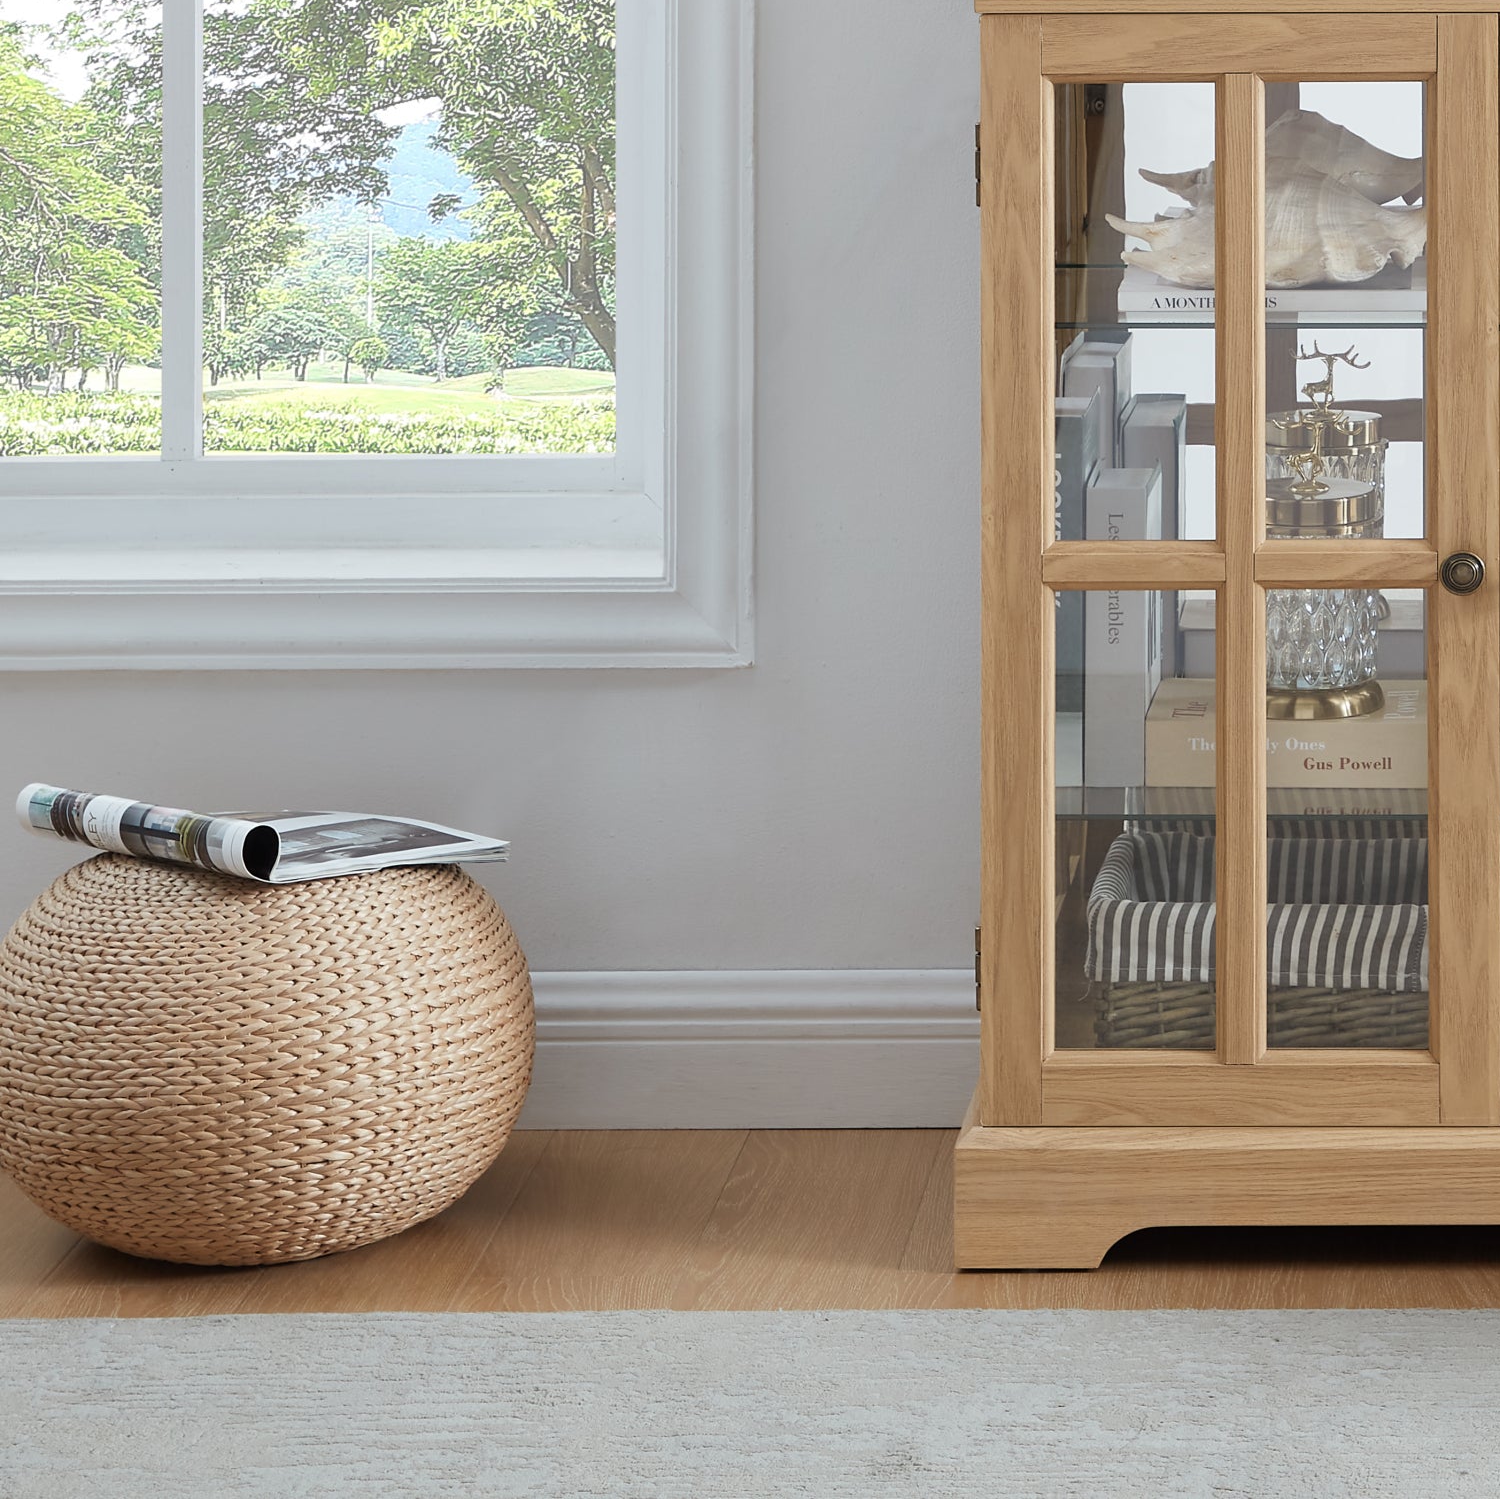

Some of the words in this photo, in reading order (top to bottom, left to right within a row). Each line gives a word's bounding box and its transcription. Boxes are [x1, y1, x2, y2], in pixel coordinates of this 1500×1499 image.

[1150, 297, 1161, 309] A
[1285, 738, 1326, 751] Ones
[1303, 757, 1333, 770] Gus
[1339, 757, 1393, 770] Powell
